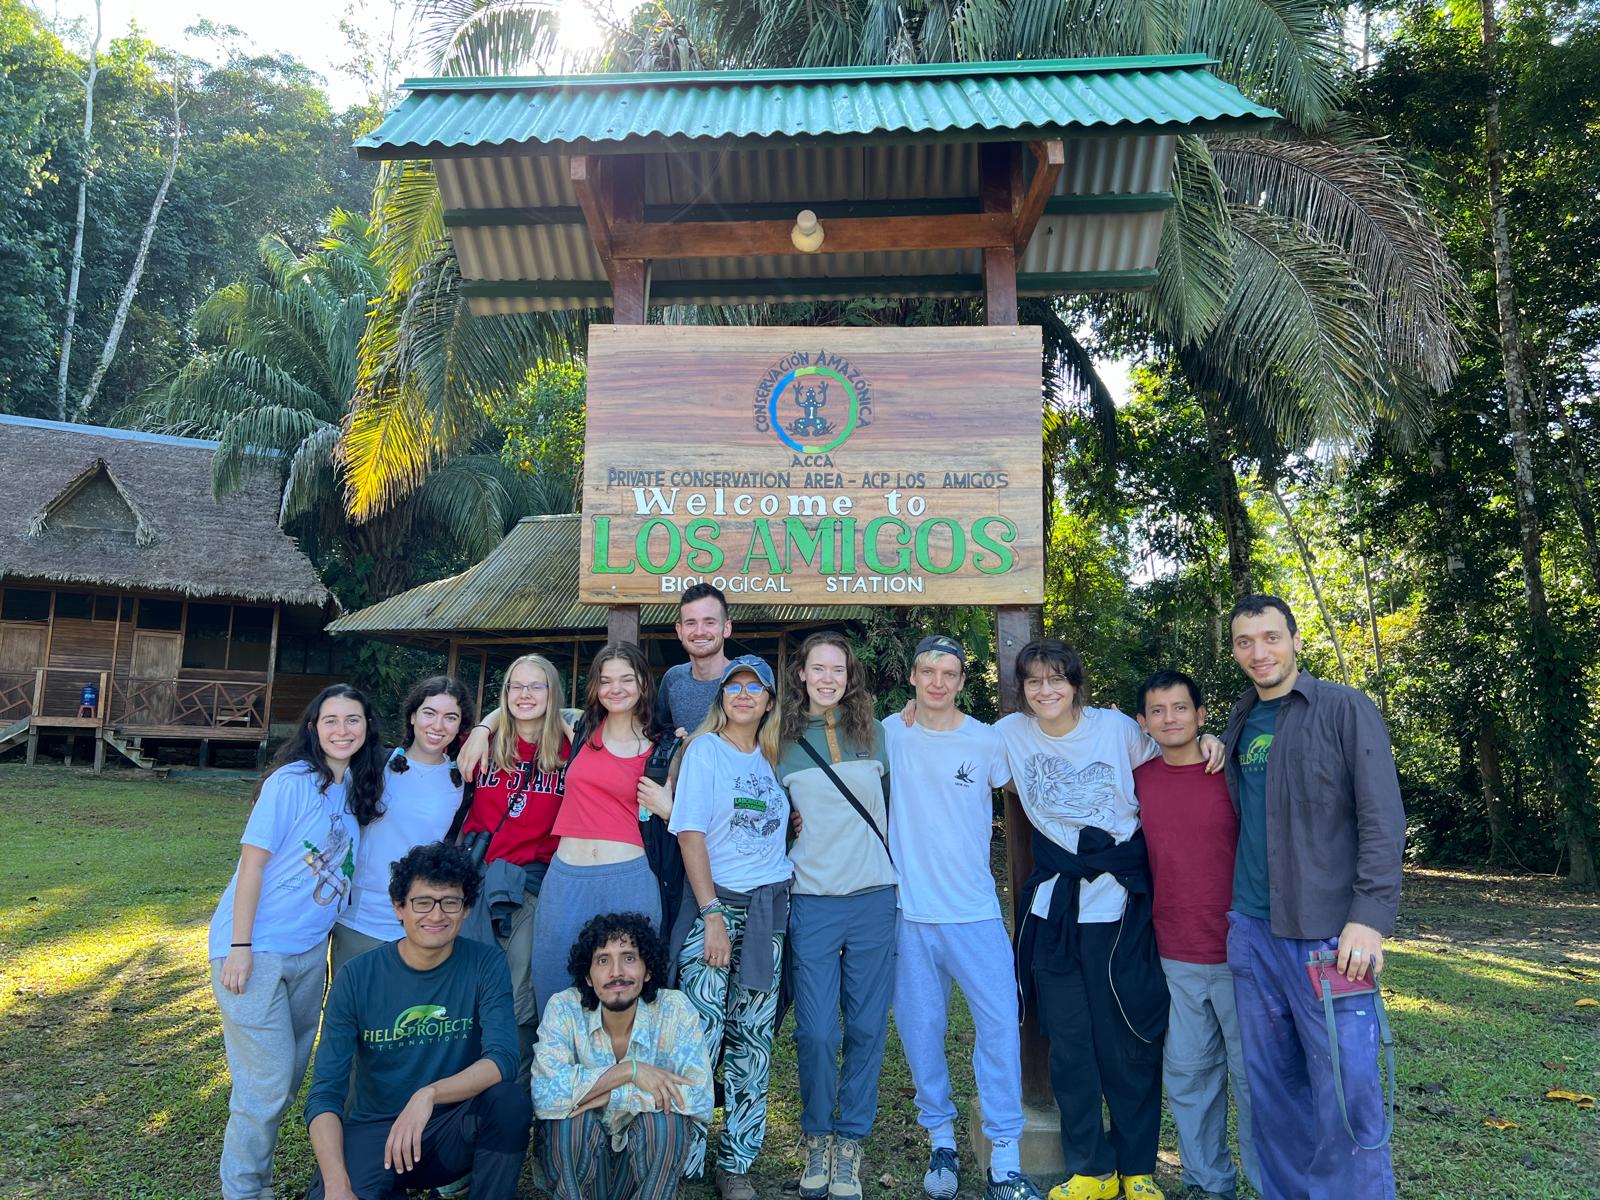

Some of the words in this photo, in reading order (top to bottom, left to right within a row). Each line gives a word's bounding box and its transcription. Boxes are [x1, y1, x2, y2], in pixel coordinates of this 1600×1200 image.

[791, 454, 834, 468] ACCA
[607, 468, 666, 487] PRIVATE
[671, 471, 791, 488] CONSERVATION
[804, 472, 844, 489] AREA
[862, 472, 890, 489] ACP
[896, 472, 926, 489] LOS
[942, 472, 1009, 489] AMIGOS
[632, 487, 854, 516] Welcome
[884, 489, 926, 516] to
[591, 516, 725, 575] LOS
[740, 516, 1017, 575] AMIGOS
[826, 576, 924, 593] STATION
[364, 1028, 404, 1042] FIELD
